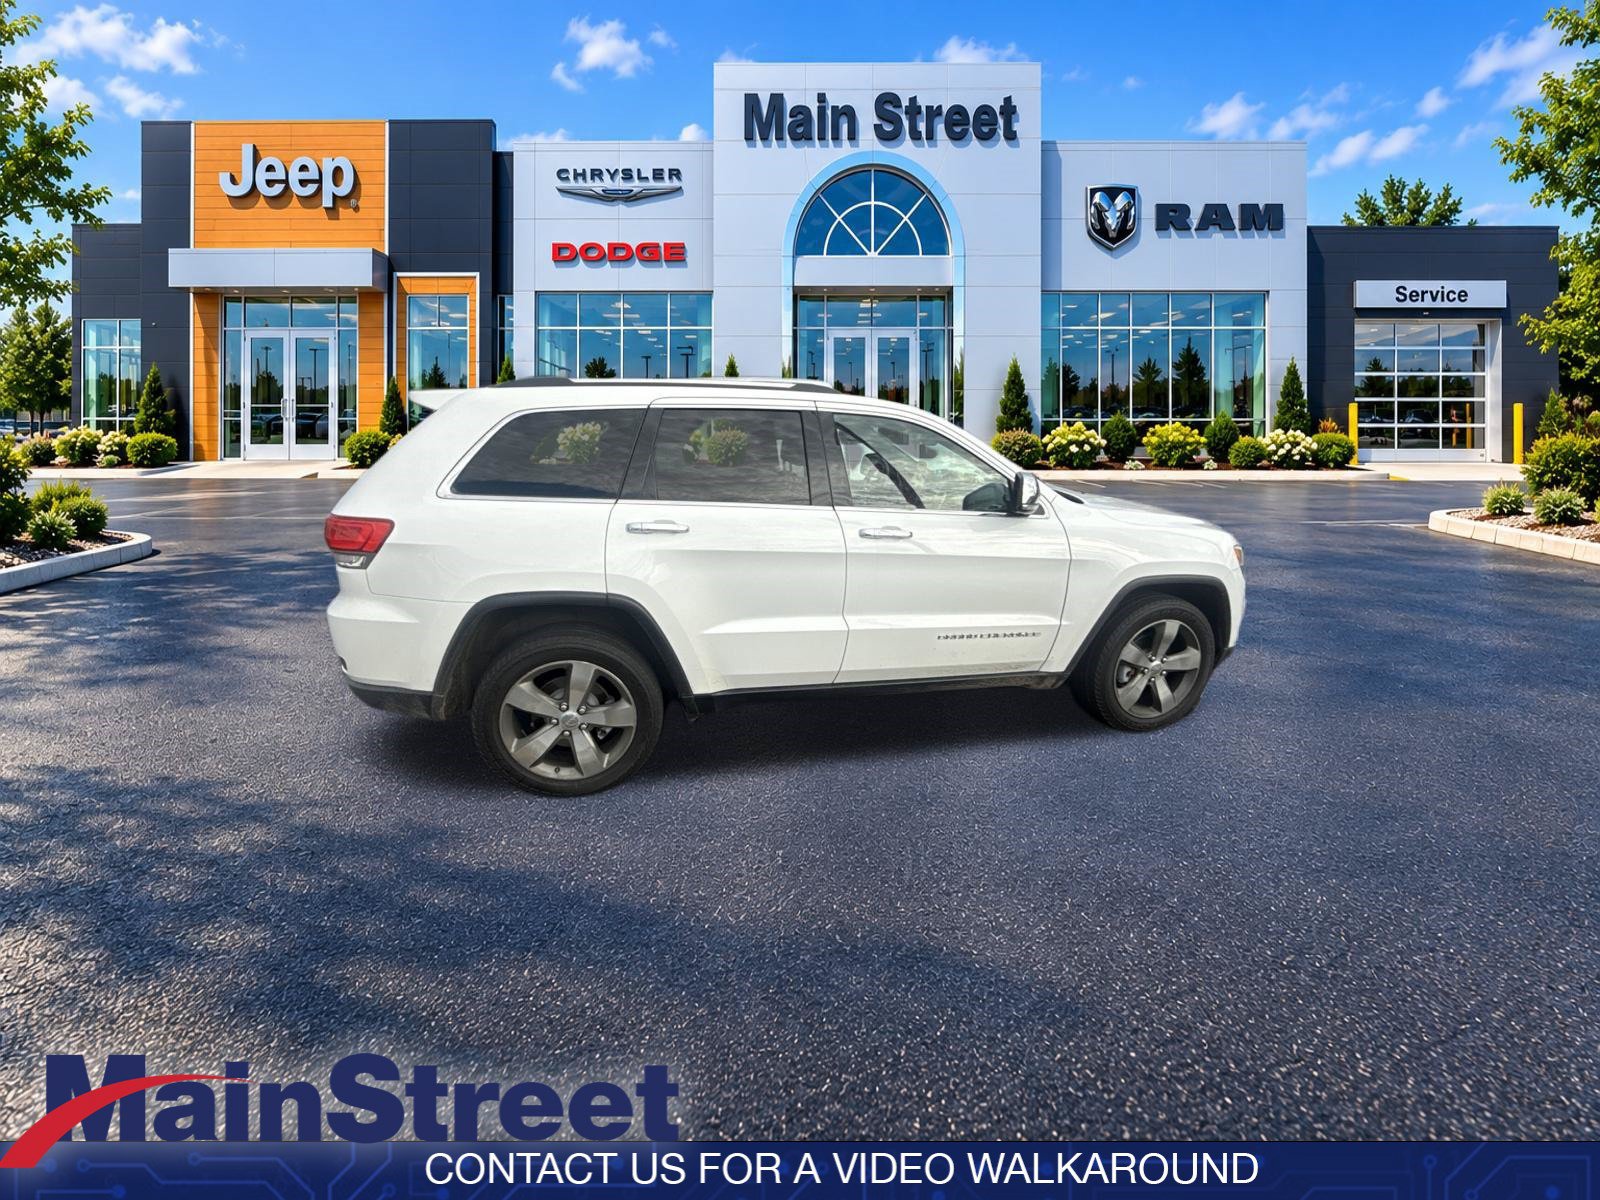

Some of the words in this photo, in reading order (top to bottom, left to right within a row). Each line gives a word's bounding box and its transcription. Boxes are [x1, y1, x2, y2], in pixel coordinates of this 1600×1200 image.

[744, 93, 856, 141] Main
[873, 91, 1018, 141] Street
[218, 143, 355, 208] Jeep
[556, 168, 682, 181] CHRYSLER
[1155, 203, 1284, 231] RAM
[552, 242, 686, 261] DODGE
[1395, 285, 1469, 303] Service
